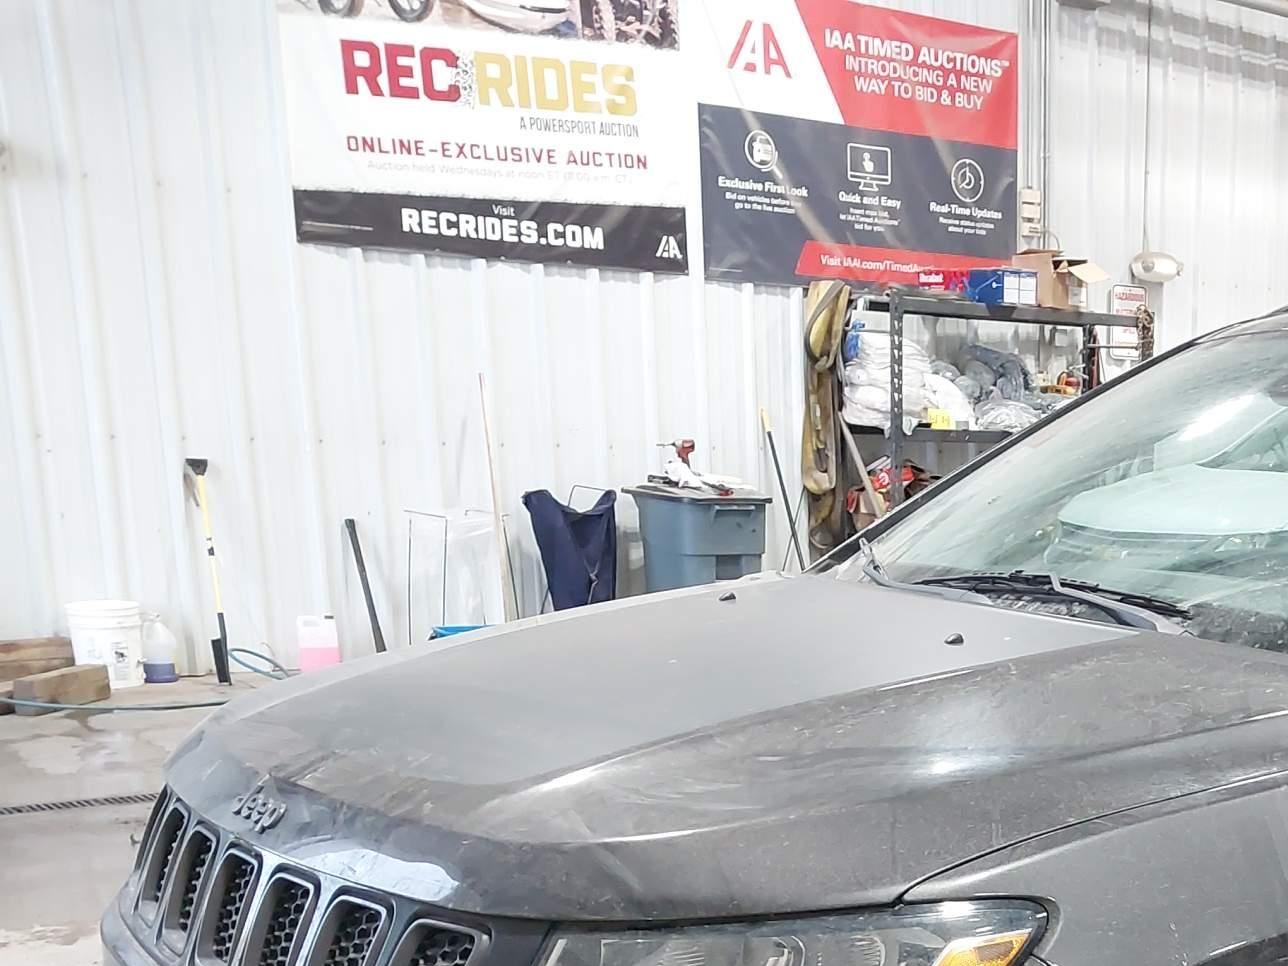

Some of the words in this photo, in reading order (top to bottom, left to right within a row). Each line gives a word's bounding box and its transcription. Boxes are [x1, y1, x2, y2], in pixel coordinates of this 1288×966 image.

[824, 28, 855, 51] IAA
[857, 34, 915, 62] TIMED
[340, 38, 462, 103] REC
[473, 50, 639, 117] RIDES
[845, 54, 944, 87] INTRODUCING
[946, 73, 958, 88] A
[960, 75, 993, 94] NEW
[854, 75, 889, 95] WAY
[891, 81, 912, 99] TO
[914, 85, 938, 104] BID
[940, 89, 952, 106] &
[954, 92, 984, 111] BUY
[519, 116, 529, 130] A
[529, 116, 597, 136] POWERSPORT
[599, 121, 640, 138] AUCTION
[346, 135, 559, 165] ONLINE-EXCLUSIVE
[566, 149, 649, 170] AUCTION
[367, 159, 409, 172] Auction
[411, 163, 436, 174] held
[439, 164, 503, 180] Wednesdays
[505, 169, 515, 178] at
[518, 170, 545, 179] noon
[718, 175, 764, 192] Exclusive
[764, 181, 786, 195] First
[786, 186, 809, 198] Look
[725, 191, 737, 200] Bid
[747, 196, 770, 204] vehicles
[491, 204, 516, 217] Visit
[734, 202, 744, 210] go
[838, 190, 862, 204] Quick
[862, 196, 879, 206] and
[880, 195, 902, 211] Easy
[929, 201, 971, 216] Real-Time
[972, 206, 1003, 219] Updates
[401, 207, 605, 250] RECRIDES.COM
[820, 254, 841, 267] Visit
[231, 773, 287, 834] Jeep
